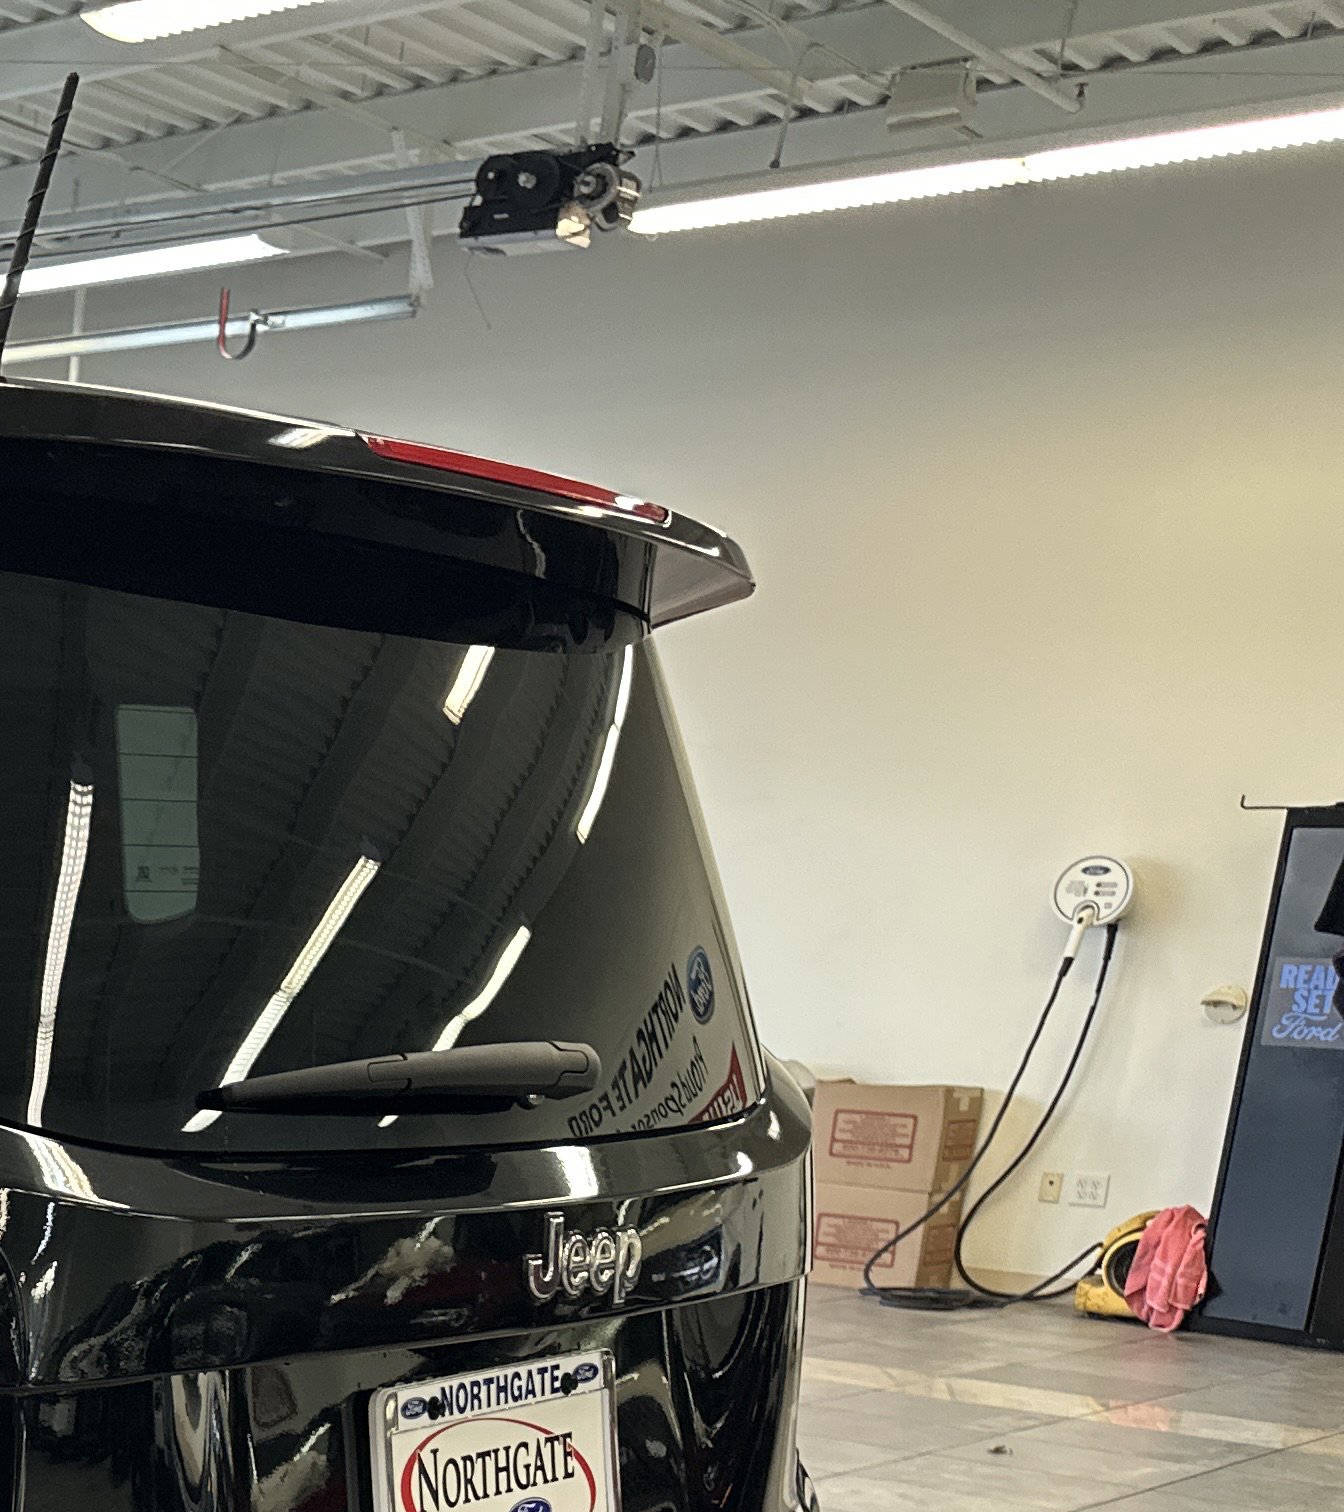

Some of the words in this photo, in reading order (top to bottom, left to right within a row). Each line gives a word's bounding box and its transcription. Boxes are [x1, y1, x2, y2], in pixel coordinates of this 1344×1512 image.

[1272, 1012, 1344, 1041] Ford
[522, 1210, 642, 1305] Jeep
[440, 1363, 562, 1418] NORTHGATE
